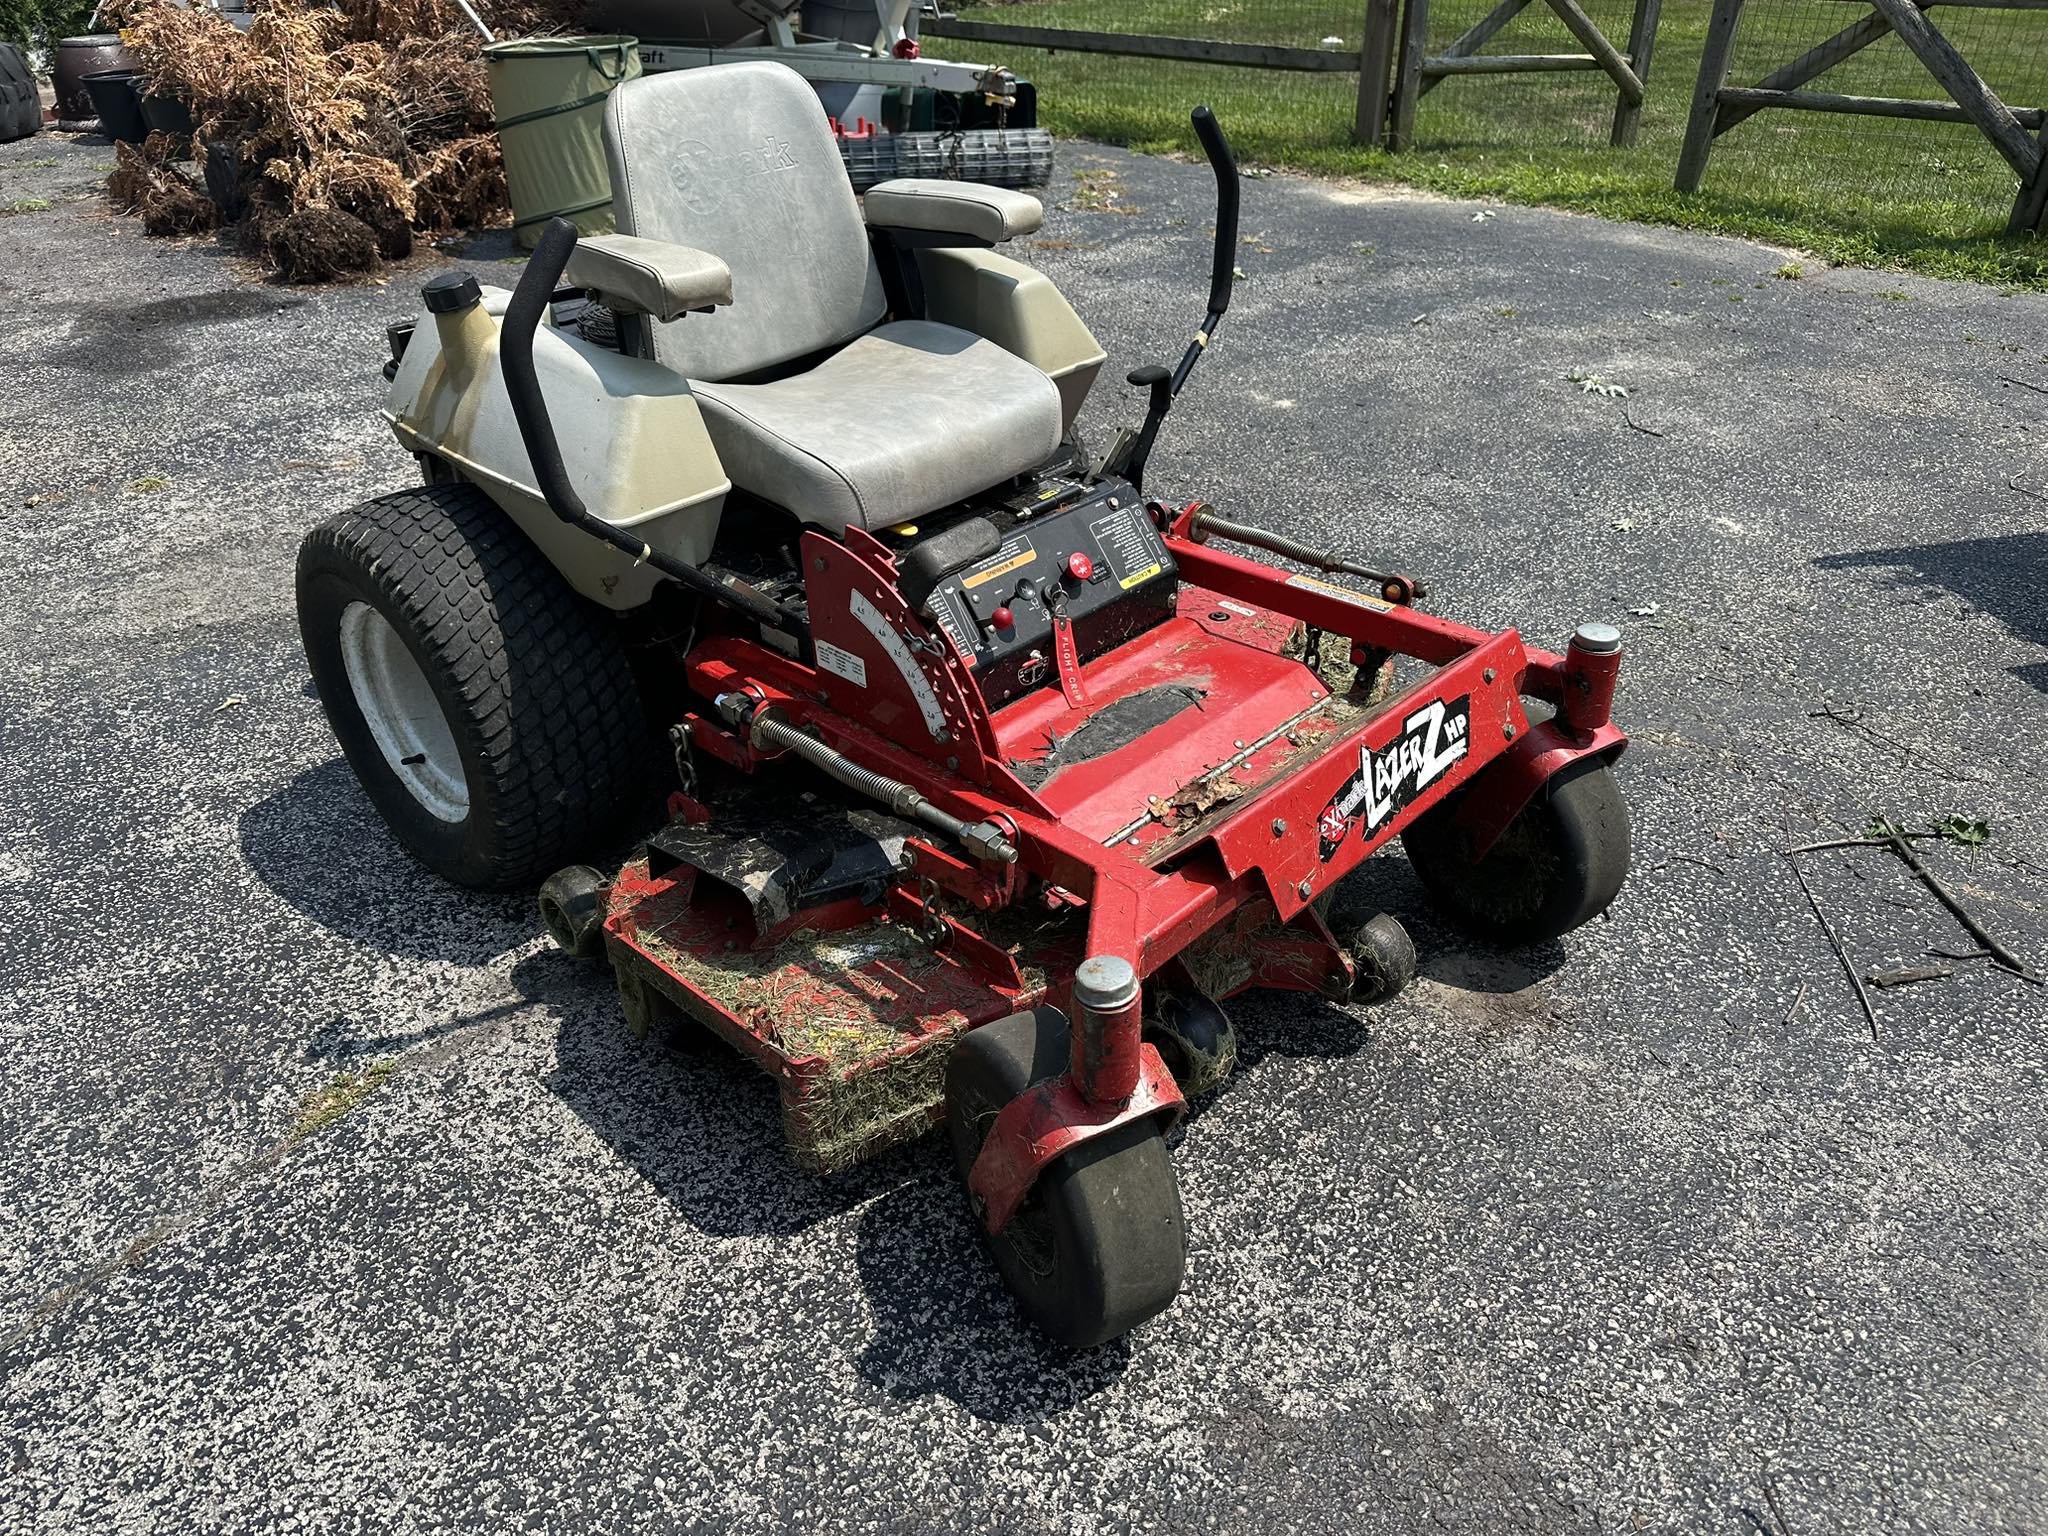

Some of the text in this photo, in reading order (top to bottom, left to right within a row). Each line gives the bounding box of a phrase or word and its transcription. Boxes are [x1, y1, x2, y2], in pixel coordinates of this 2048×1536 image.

[1127, 570, 1149, 584] CAUTION
[1062, 636, 1084, 701] FLIGHT CREW
[1443, 713, 1467, 743] HP
